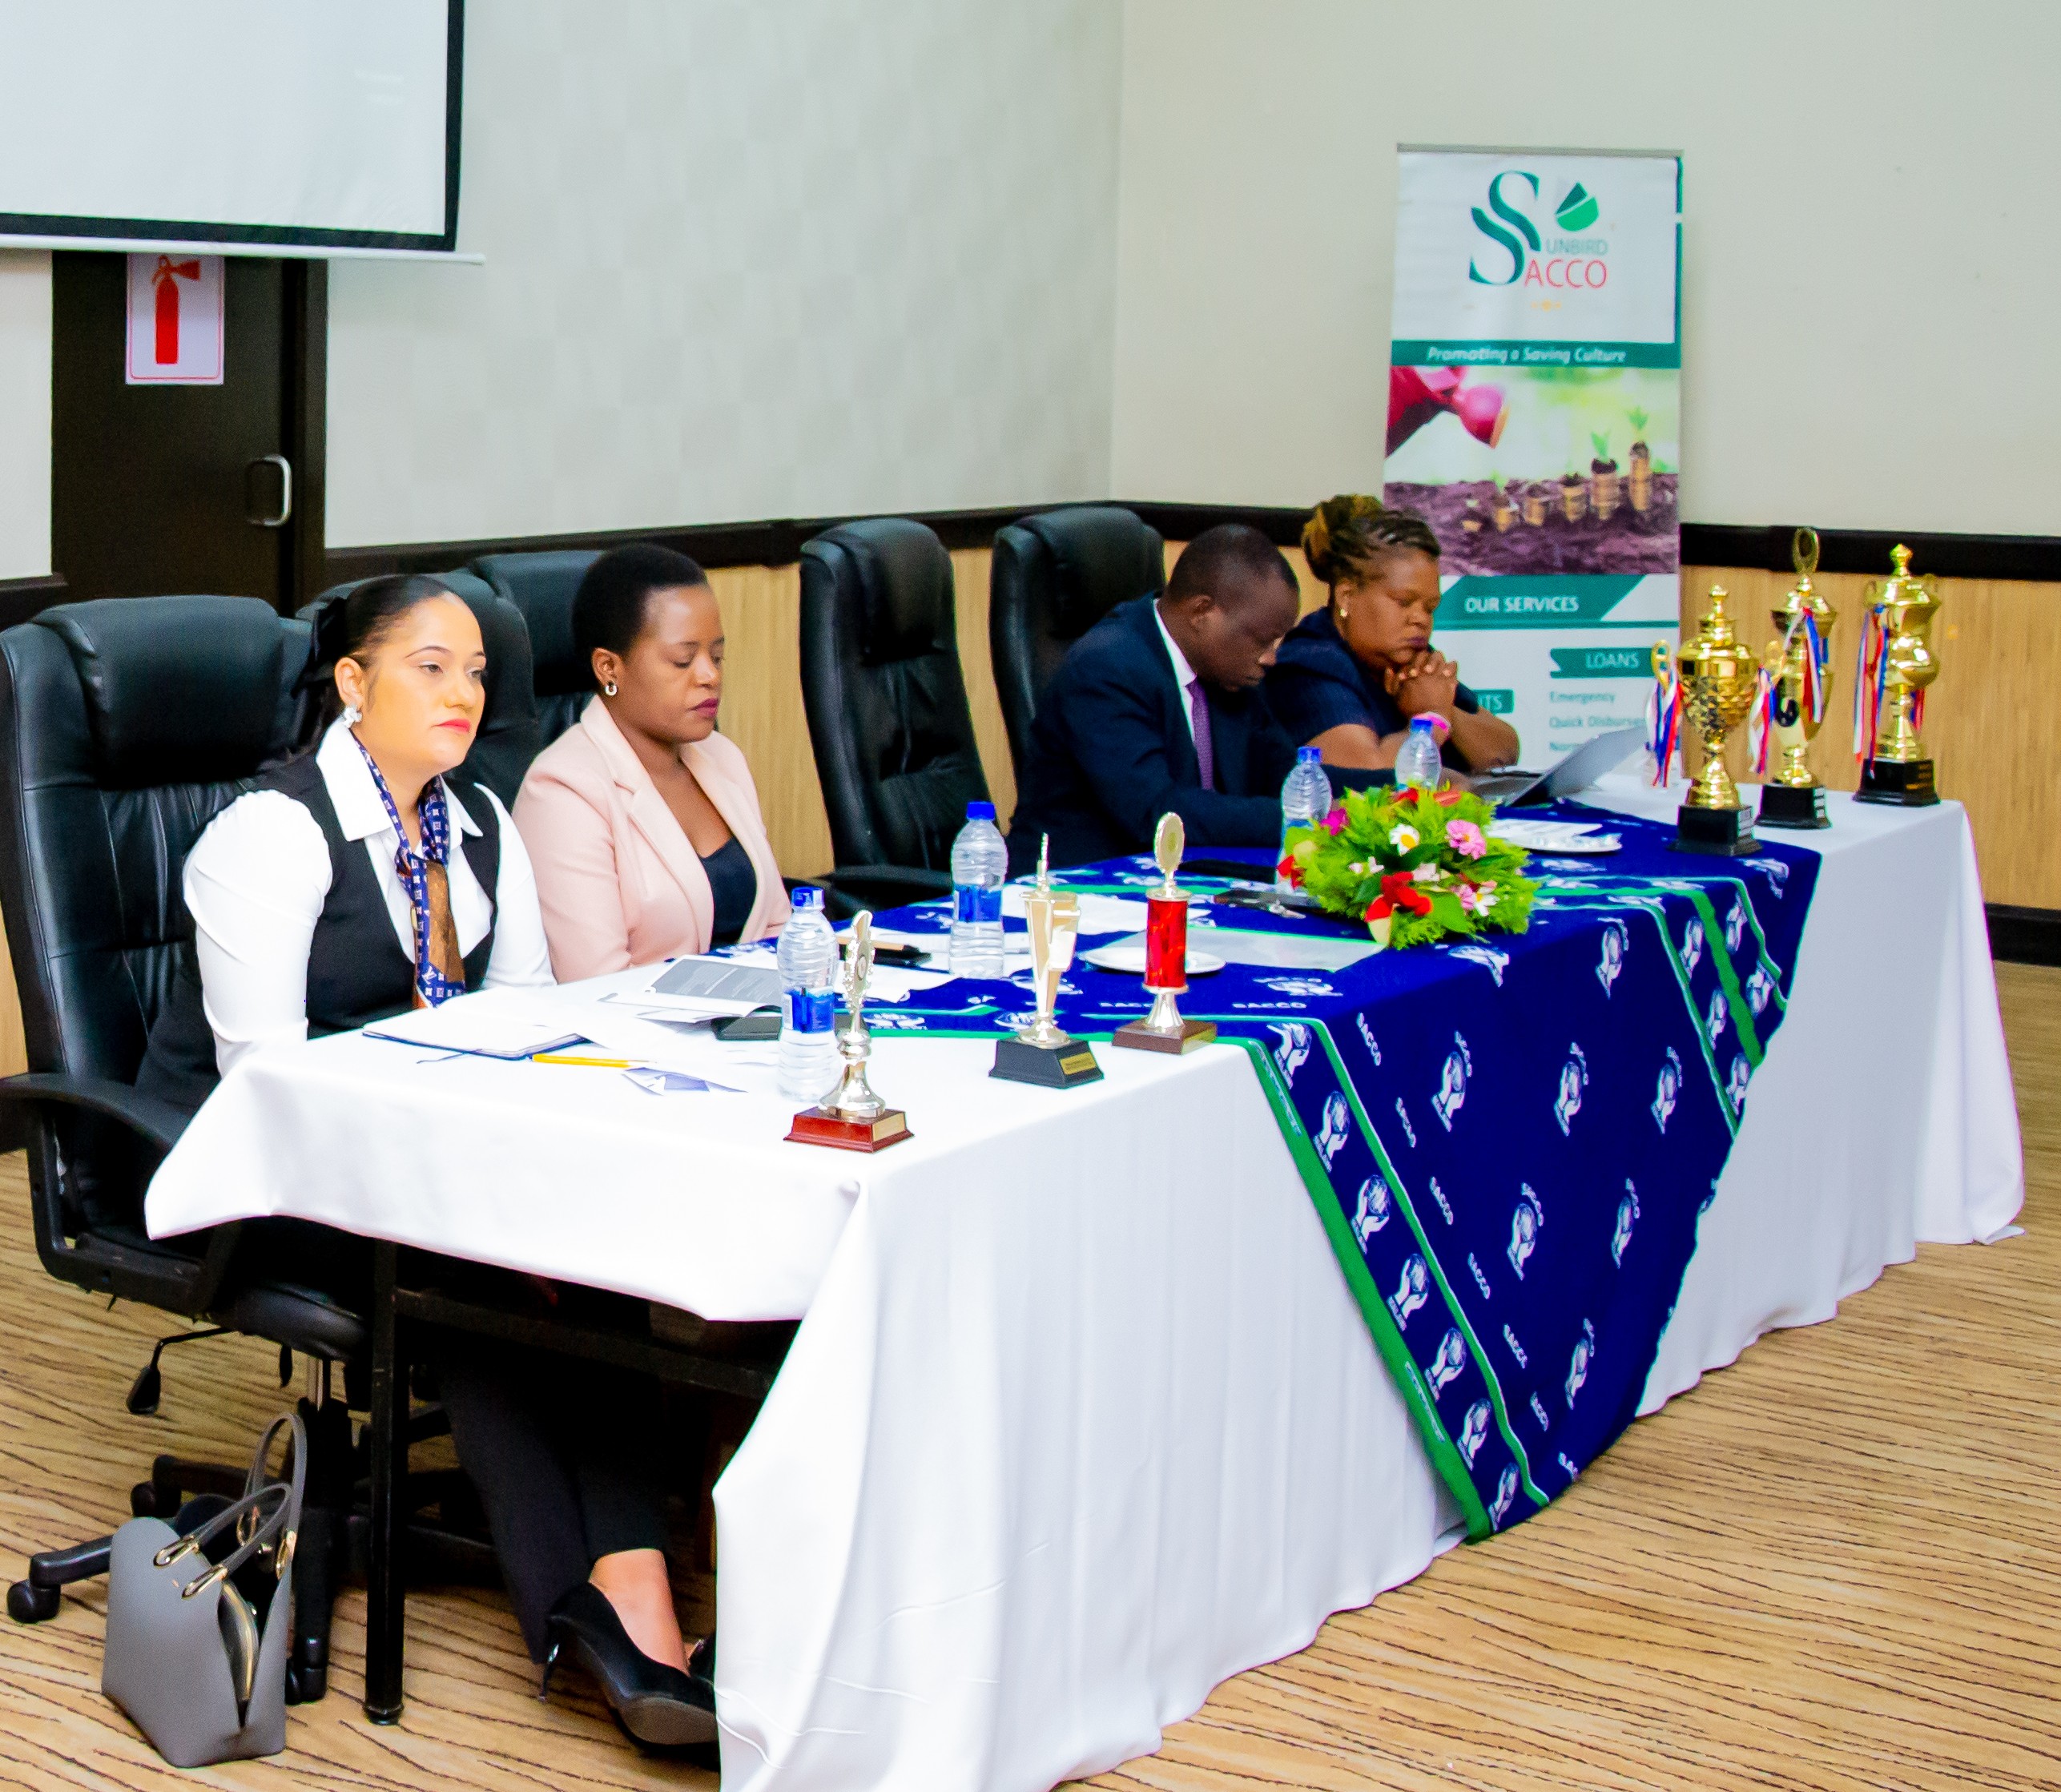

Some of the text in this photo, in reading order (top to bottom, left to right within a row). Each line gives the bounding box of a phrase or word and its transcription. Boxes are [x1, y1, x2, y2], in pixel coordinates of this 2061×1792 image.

[1427, 346, 1626, 364] Promoting a Saving Culture
[1465, 596, 1580, 613] OUR SERVICES
[1585, 652, 1640, 669] LOANS
[1549, 691, 1616, 705] Emergency
[1549, 716, 1583, 727] Quick
